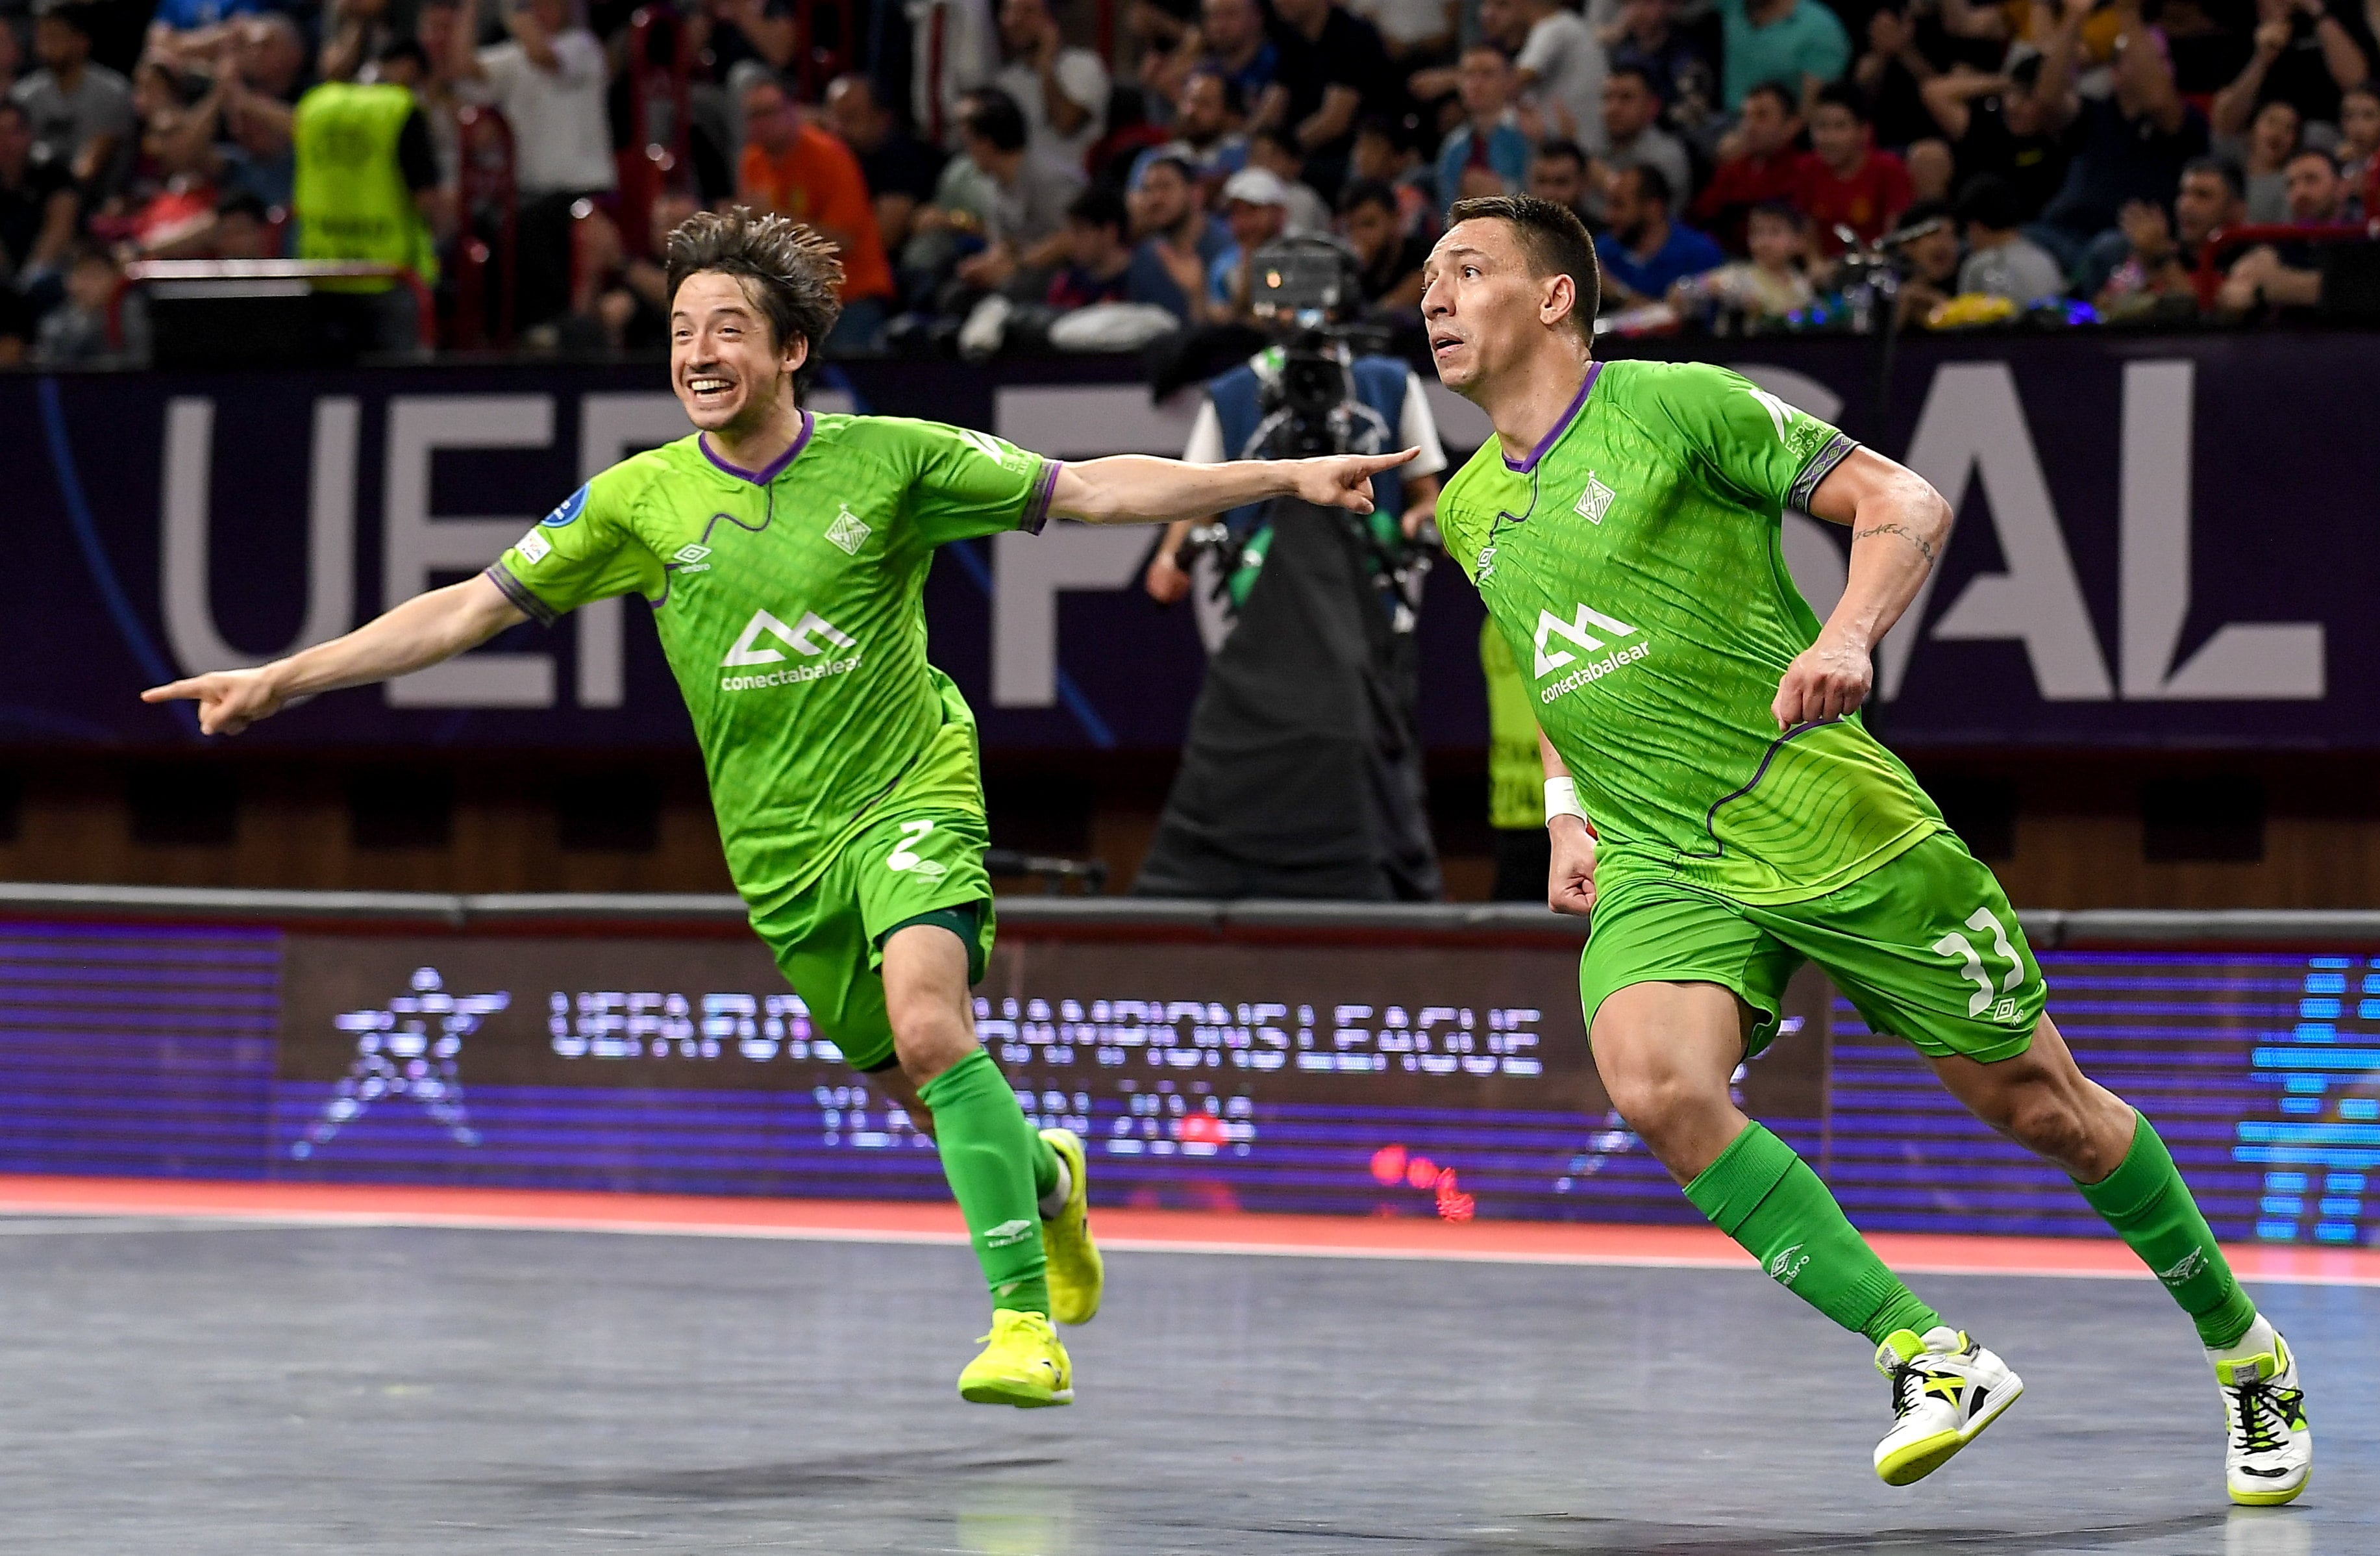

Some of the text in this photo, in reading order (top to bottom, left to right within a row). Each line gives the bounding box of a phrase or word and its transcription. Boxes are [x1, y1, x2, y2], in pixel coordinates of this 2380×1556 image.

[1541, 640, 1650, 705] conectabalear
[886, 819, 934, 872] 2
[1931, 906, 2025, 1018] 33
[548, 991, 695, 1058] UEFA
[972, 996, 1290, 1070] HAMPIONS
[1296, 1004, 1544, 1076] LEAGUE
